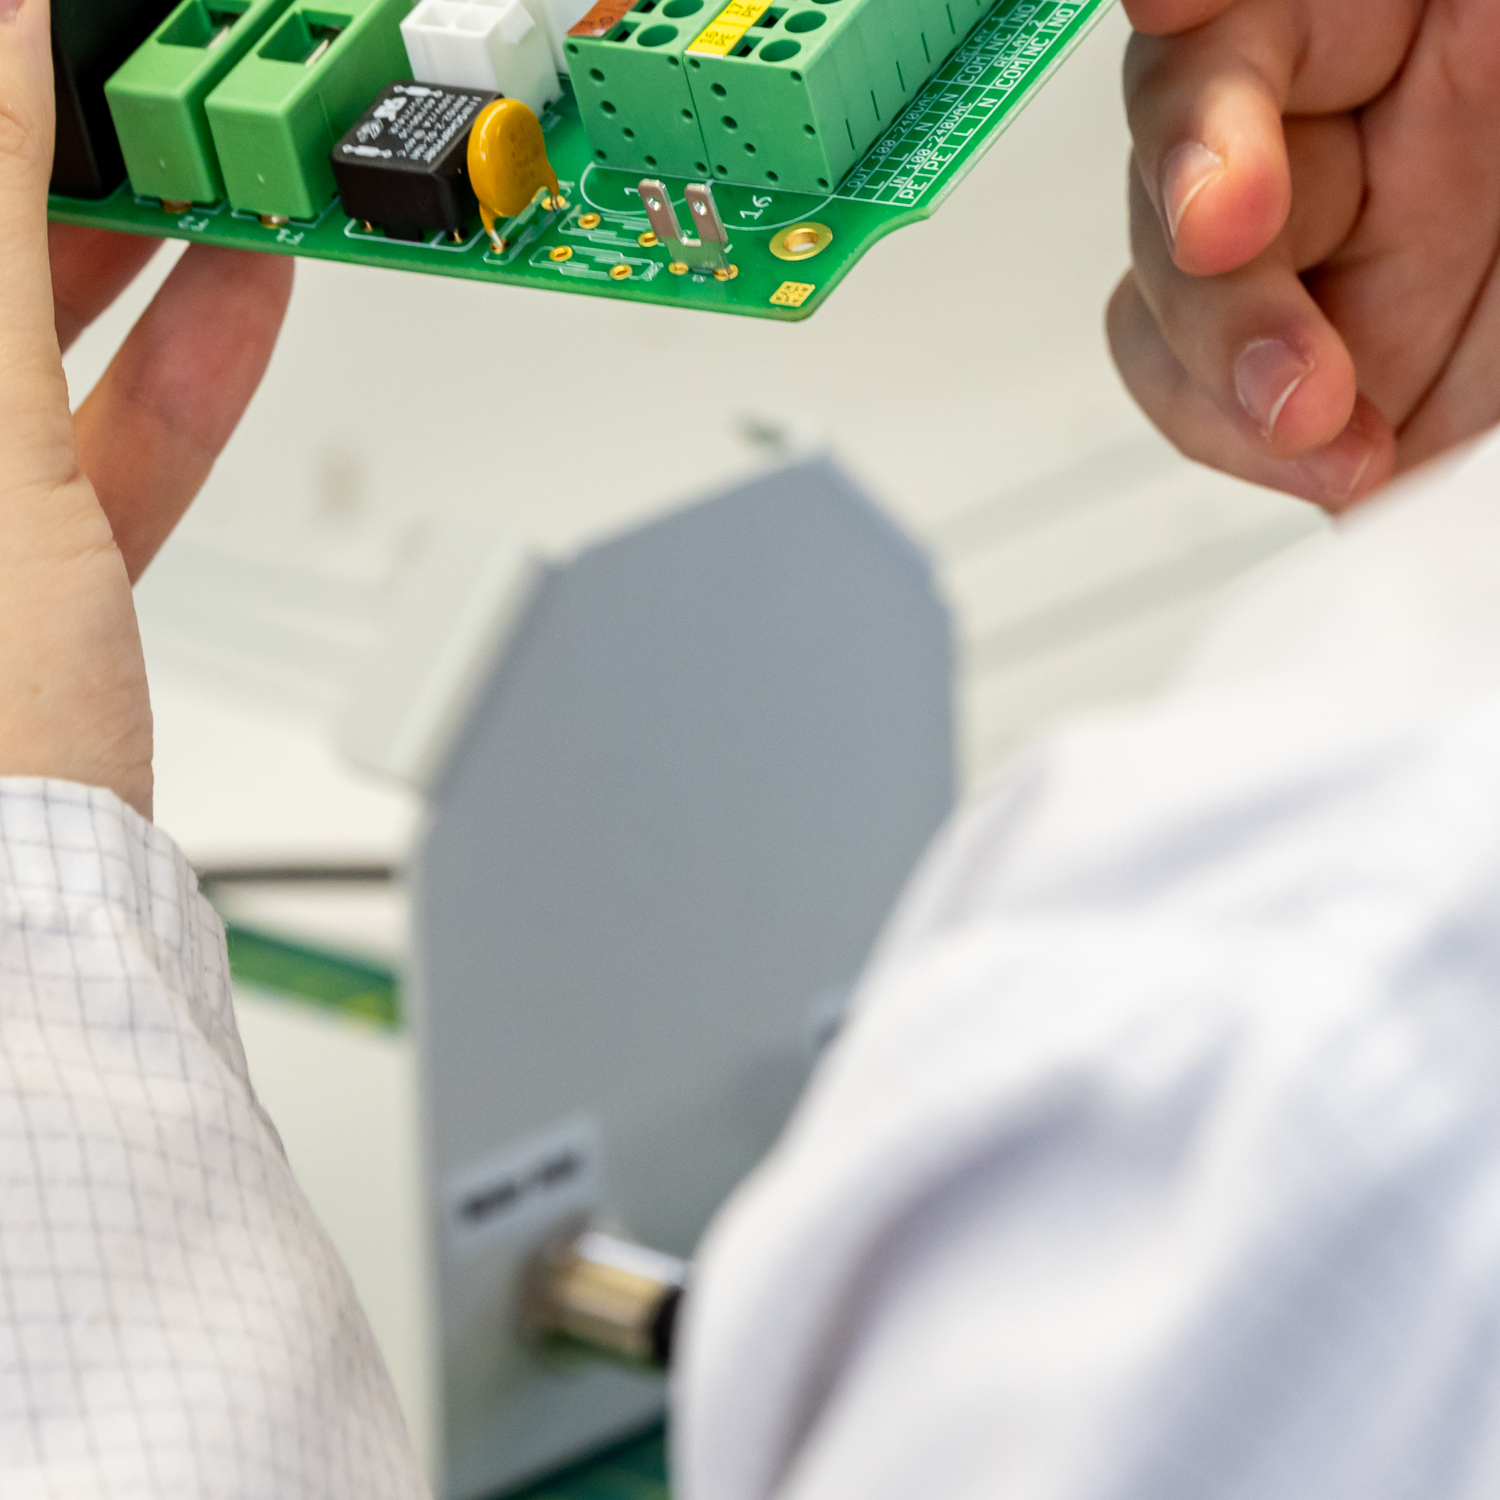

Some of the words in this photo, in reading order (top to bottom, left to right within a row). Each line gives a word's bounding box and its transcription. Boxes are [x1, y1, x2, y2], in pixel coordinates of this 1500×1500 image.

[724, 2, 746, 15] 17
[739, 3, 763, 17] PE
[698, 30, 721, 44] 16
[712, 32, 737, 46] PE
[953, 27, 995, 62] RELAY
[954, 55, 992, 83] COM
[983, 31, 1014, 50] NC
[1007, 3, 1039, 22] NO
[991, 32, 1034, 67] RELAY
[1026, 18, 1045, 27] 2
[992, 59, 1032, 87] COM
[1020, 37, 1052, 56] NC
[1045, 7, 1077, 27] NO
[844, 167, 873, 188] OUT
[867, 92, 939, 160] 100-240VAC
[862, 178, 886, 189] L
[887, 150, 910, 161] L
[912, 121, 935, 131] N
[938, 92, 960, 102] N
[887, 175, 909, 188] IN
[903, 101, 973, 170] 100-240VAC
[897, 179, 928, 199] PE
[921, 150, 953, 170] PE
[951, 126, 974, 136] L
[975, 97, 999, 107] N
[739, 194, 773, 221] 16
